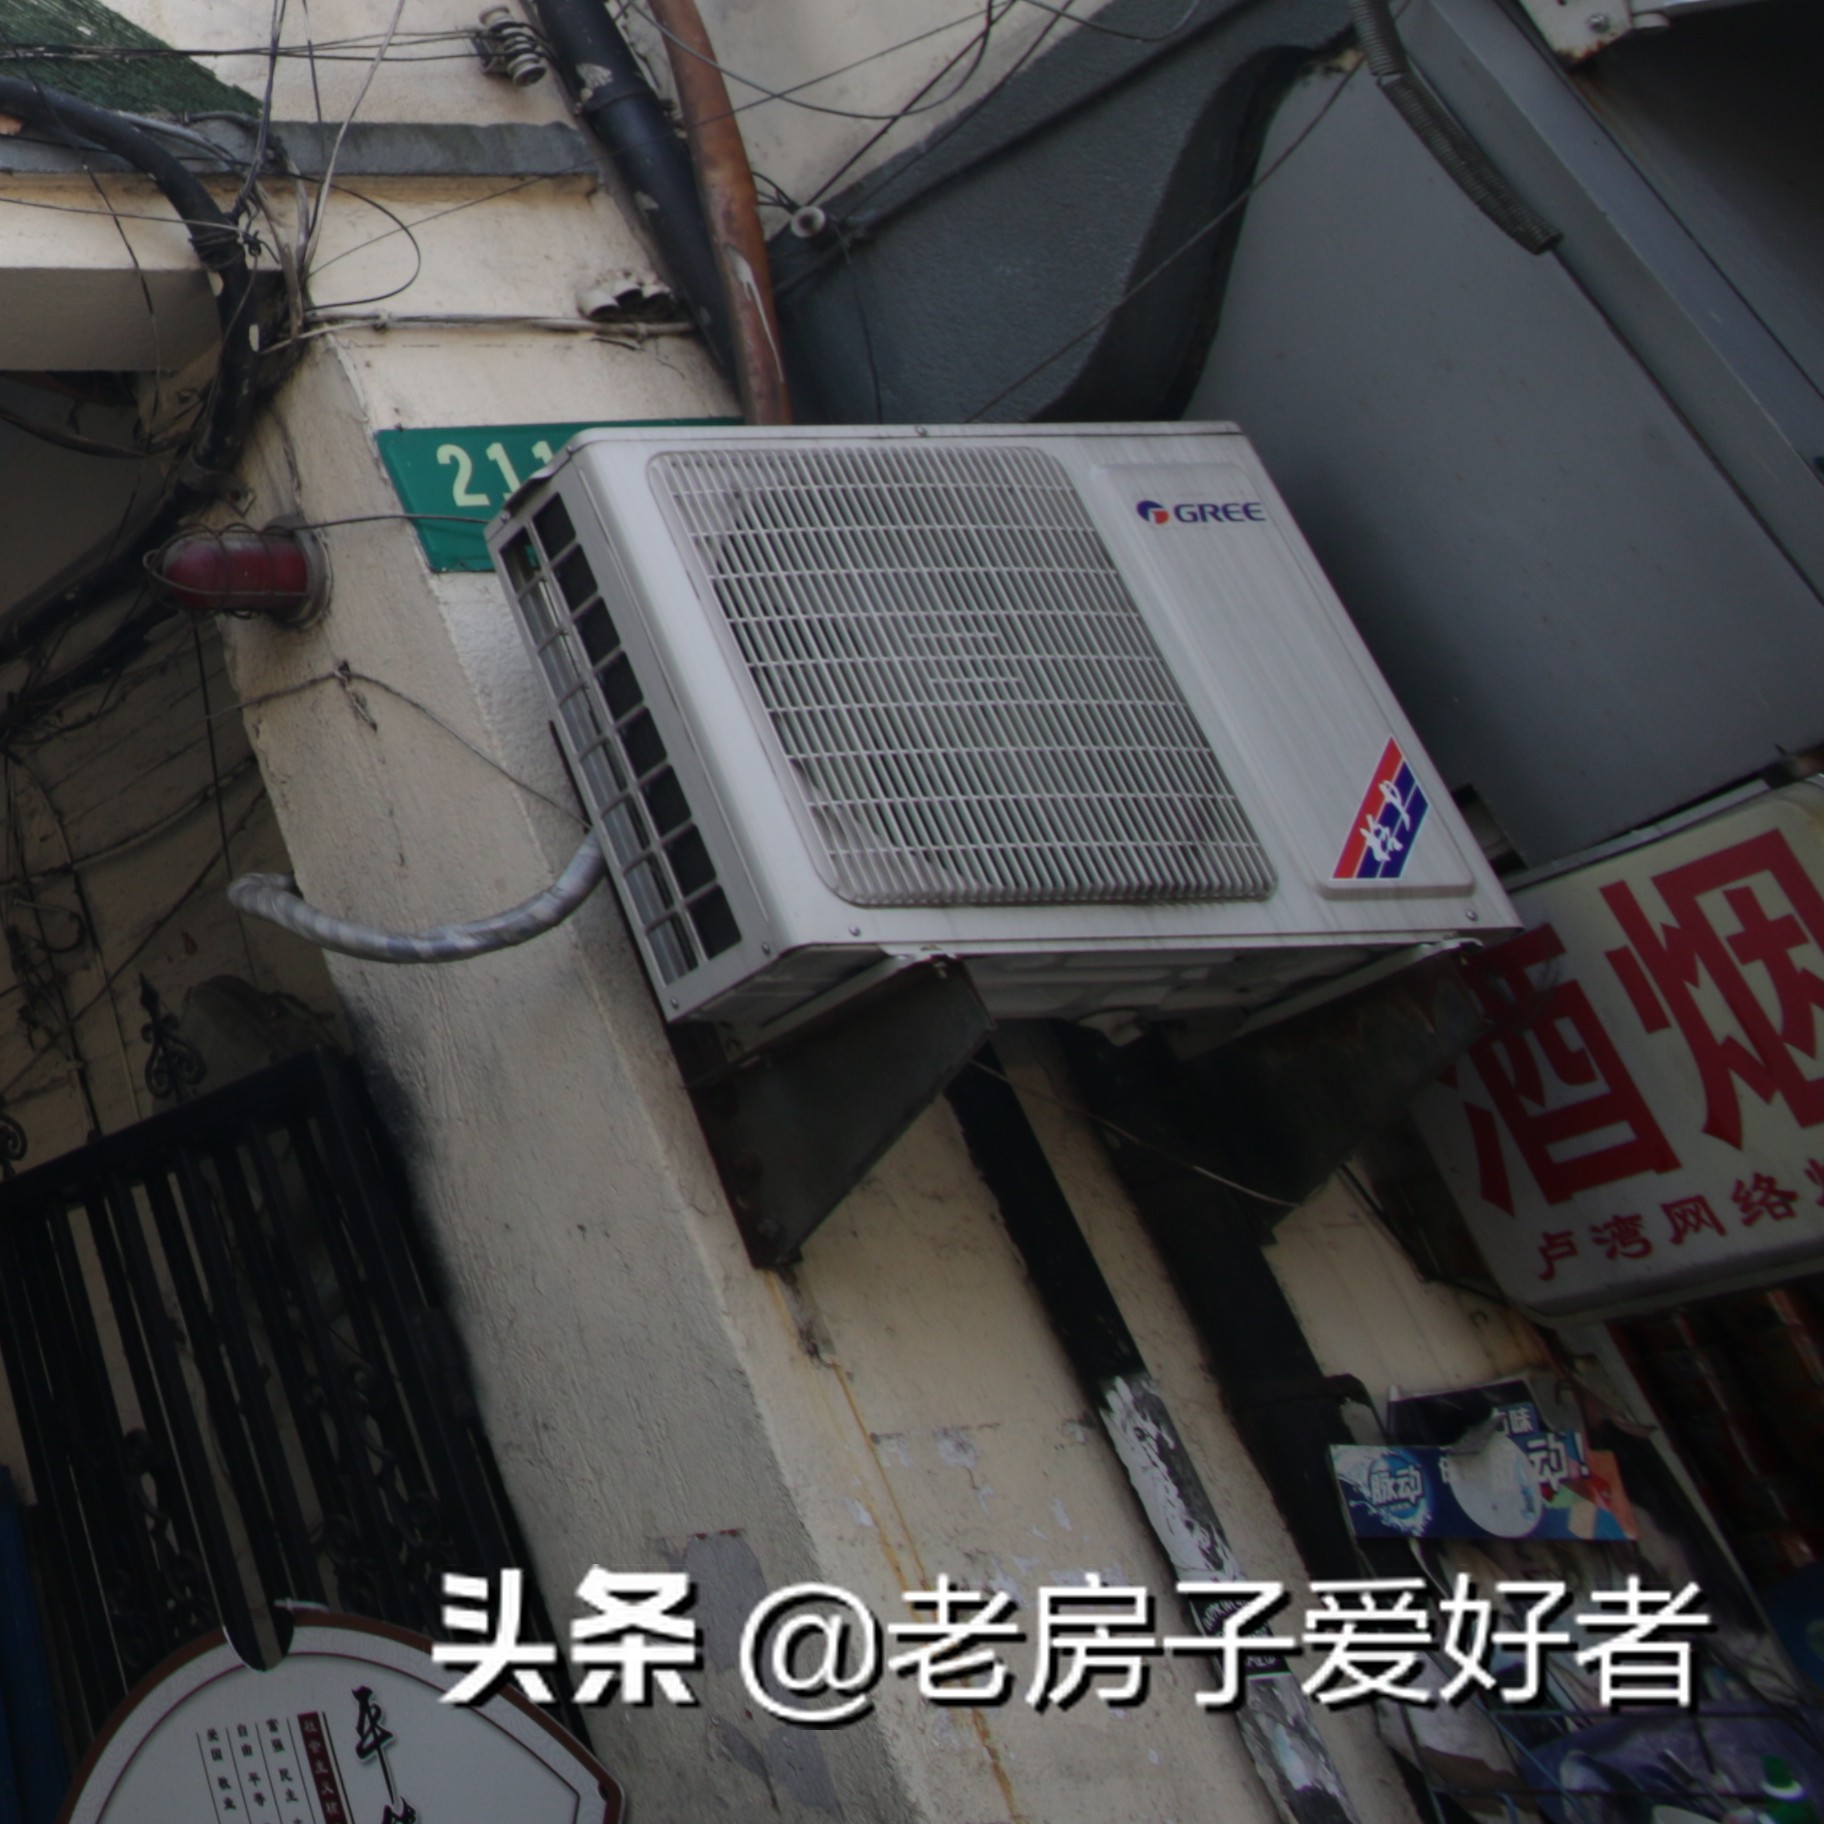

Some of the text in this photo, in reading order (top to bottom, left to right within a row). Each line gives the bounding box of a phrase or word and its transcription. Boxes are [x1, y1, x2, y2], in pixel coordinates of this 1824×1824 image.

[436, 440, 553, 507] 21
[1173, 502, 1267, 524] GREE
[1370, 1464, 1424, 1507] 脉动
